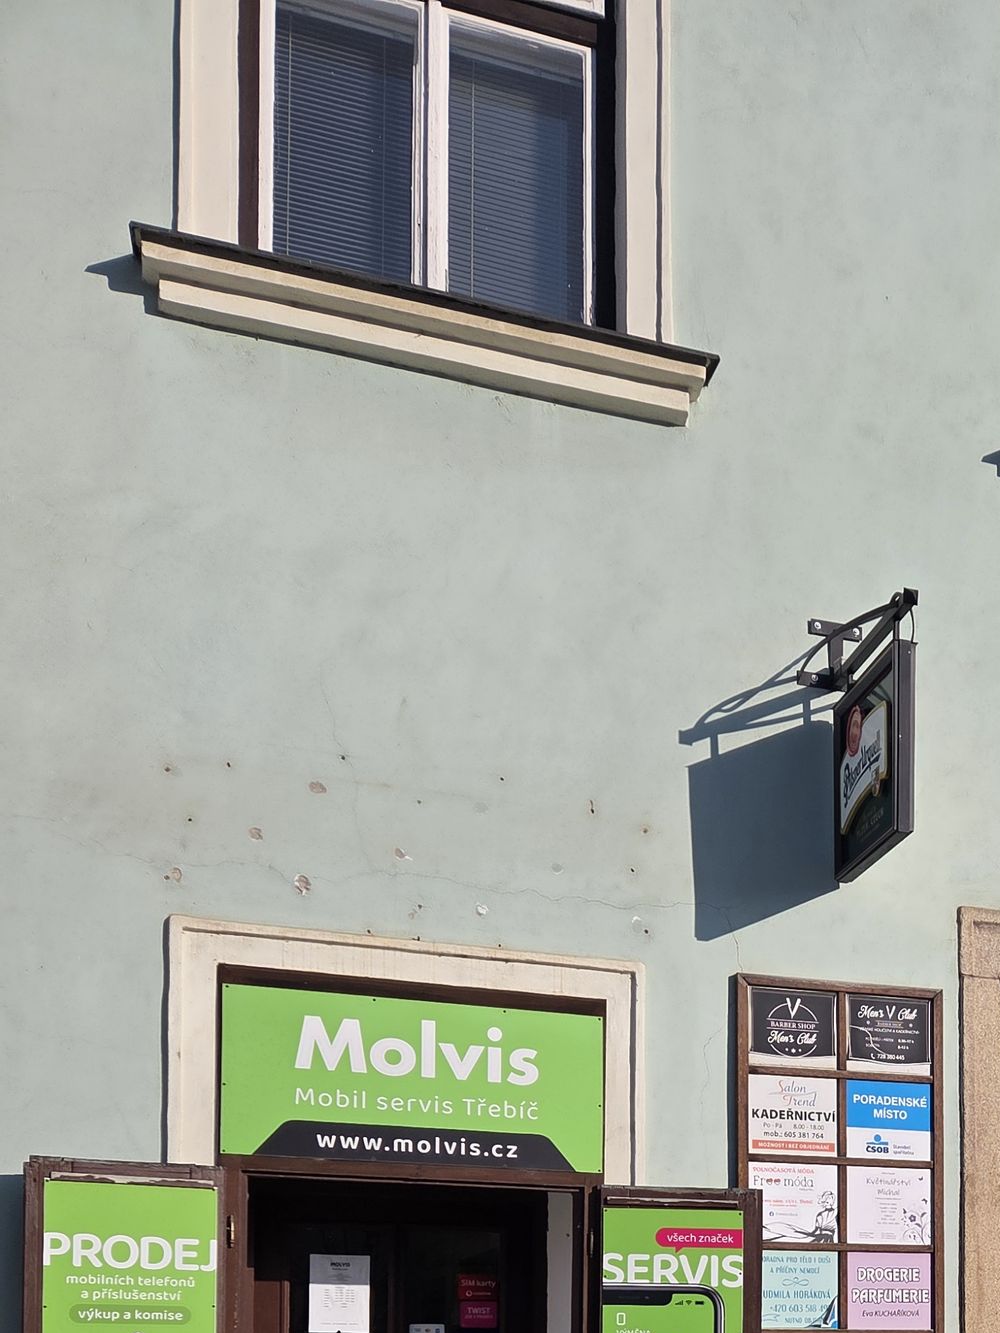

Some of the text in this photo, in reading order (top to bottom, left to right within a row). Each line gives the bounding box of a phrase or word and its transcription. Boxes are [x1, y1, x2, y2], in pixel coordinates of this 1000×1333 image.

[771, 1020, 797, 1029] BARBER
[295, 1015, 539, 1086] Molvis
[778, 1080, 806, 1093] Salon
[295, 1087, 539, 1120] Mobil servis Třebíč
[783, 1094, 817, 1106] Trend
[853, 1094, 927, 1108] PORADENSKÉ
[752, 1108, 835, 1122] KADEŘNICTVÍ
[874, 1108, 907, 1120] MÍSTO
[316, 1133, 518, 1158] www.molvis.cz
[753, 1175, 814, 1187] Free móda
[667, 1233, 734, 1244] všech značek
[43, 1232, 218, 1272] PRODEJ
[603, 1253, 743, 1288] SERVIS
[857, 1267, 920, 1283] DROGERIE
[66, 1274, 195, 1288] mobilních telefonů
[476, 1280, 496, 1288] karty
[92, 1288, 182, 1302] příslušenství
[763, 1290, 790, 1299] UDMILA
[852, 1288, 929, 1305] PARFUMERIE
[78, 1309, 183, 1321] výkup a komise
